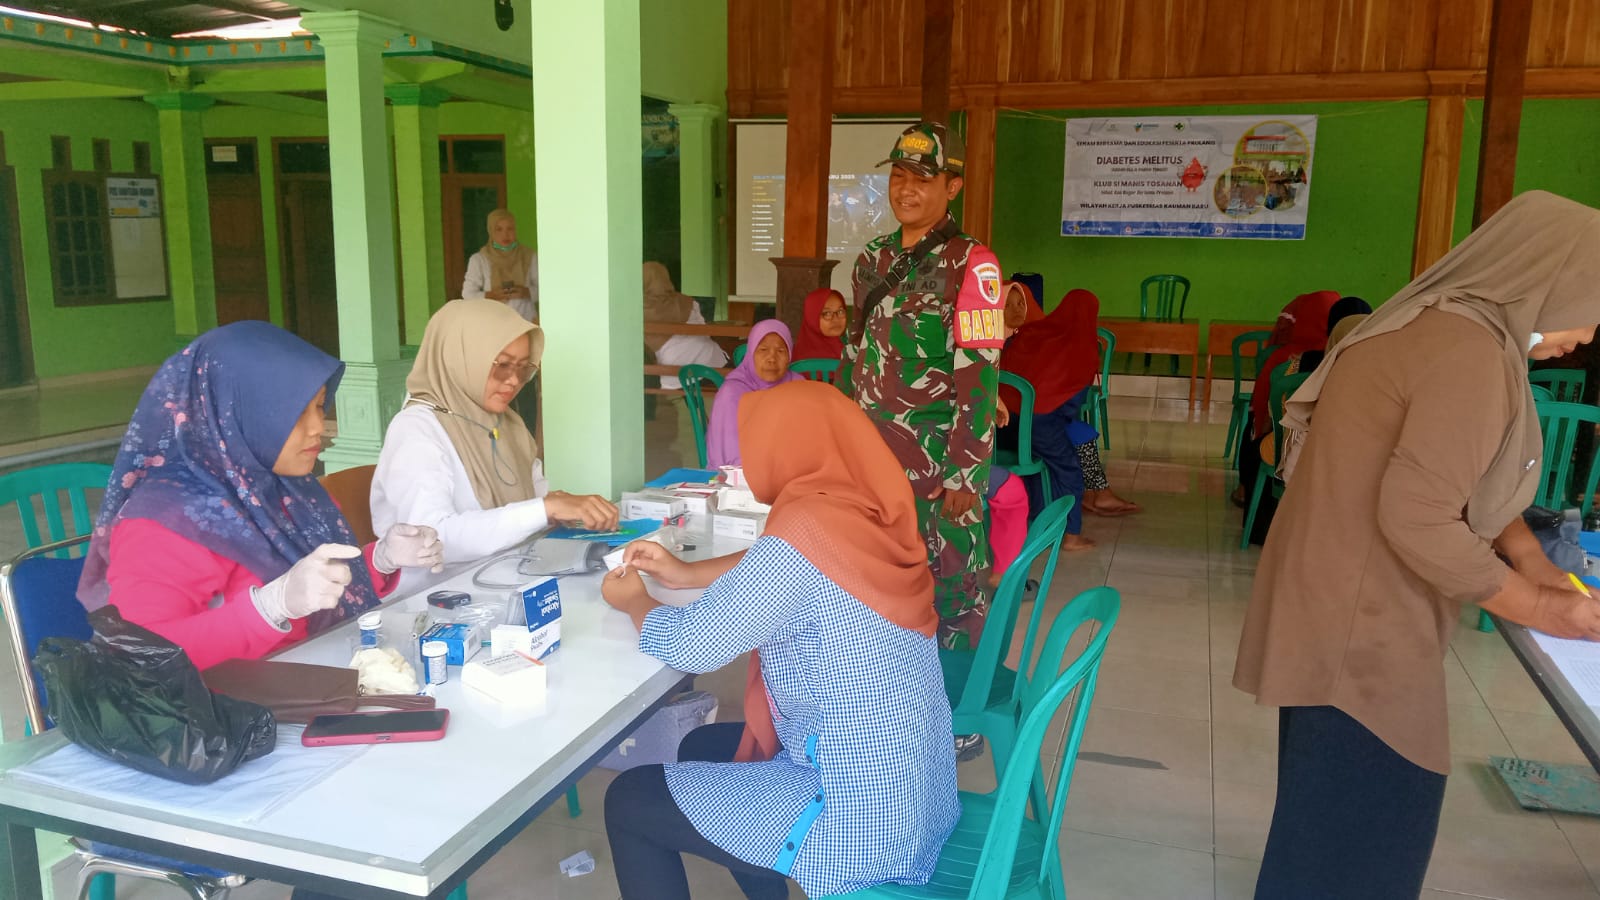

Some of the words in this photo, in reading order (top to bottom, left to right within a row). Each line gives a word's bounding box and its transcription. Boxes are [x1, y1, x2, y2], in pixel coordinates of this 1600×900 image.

[1096, 156, 1141, 165] DIABETES
[1142, 156, 1183, 165] MELITUS
[901, 281, 916, 293] TNI
[920, 280, 937, 291] AD
[541, 601, 560, 617] Alcohol
[530, 629, 549, 645] Alcohol
